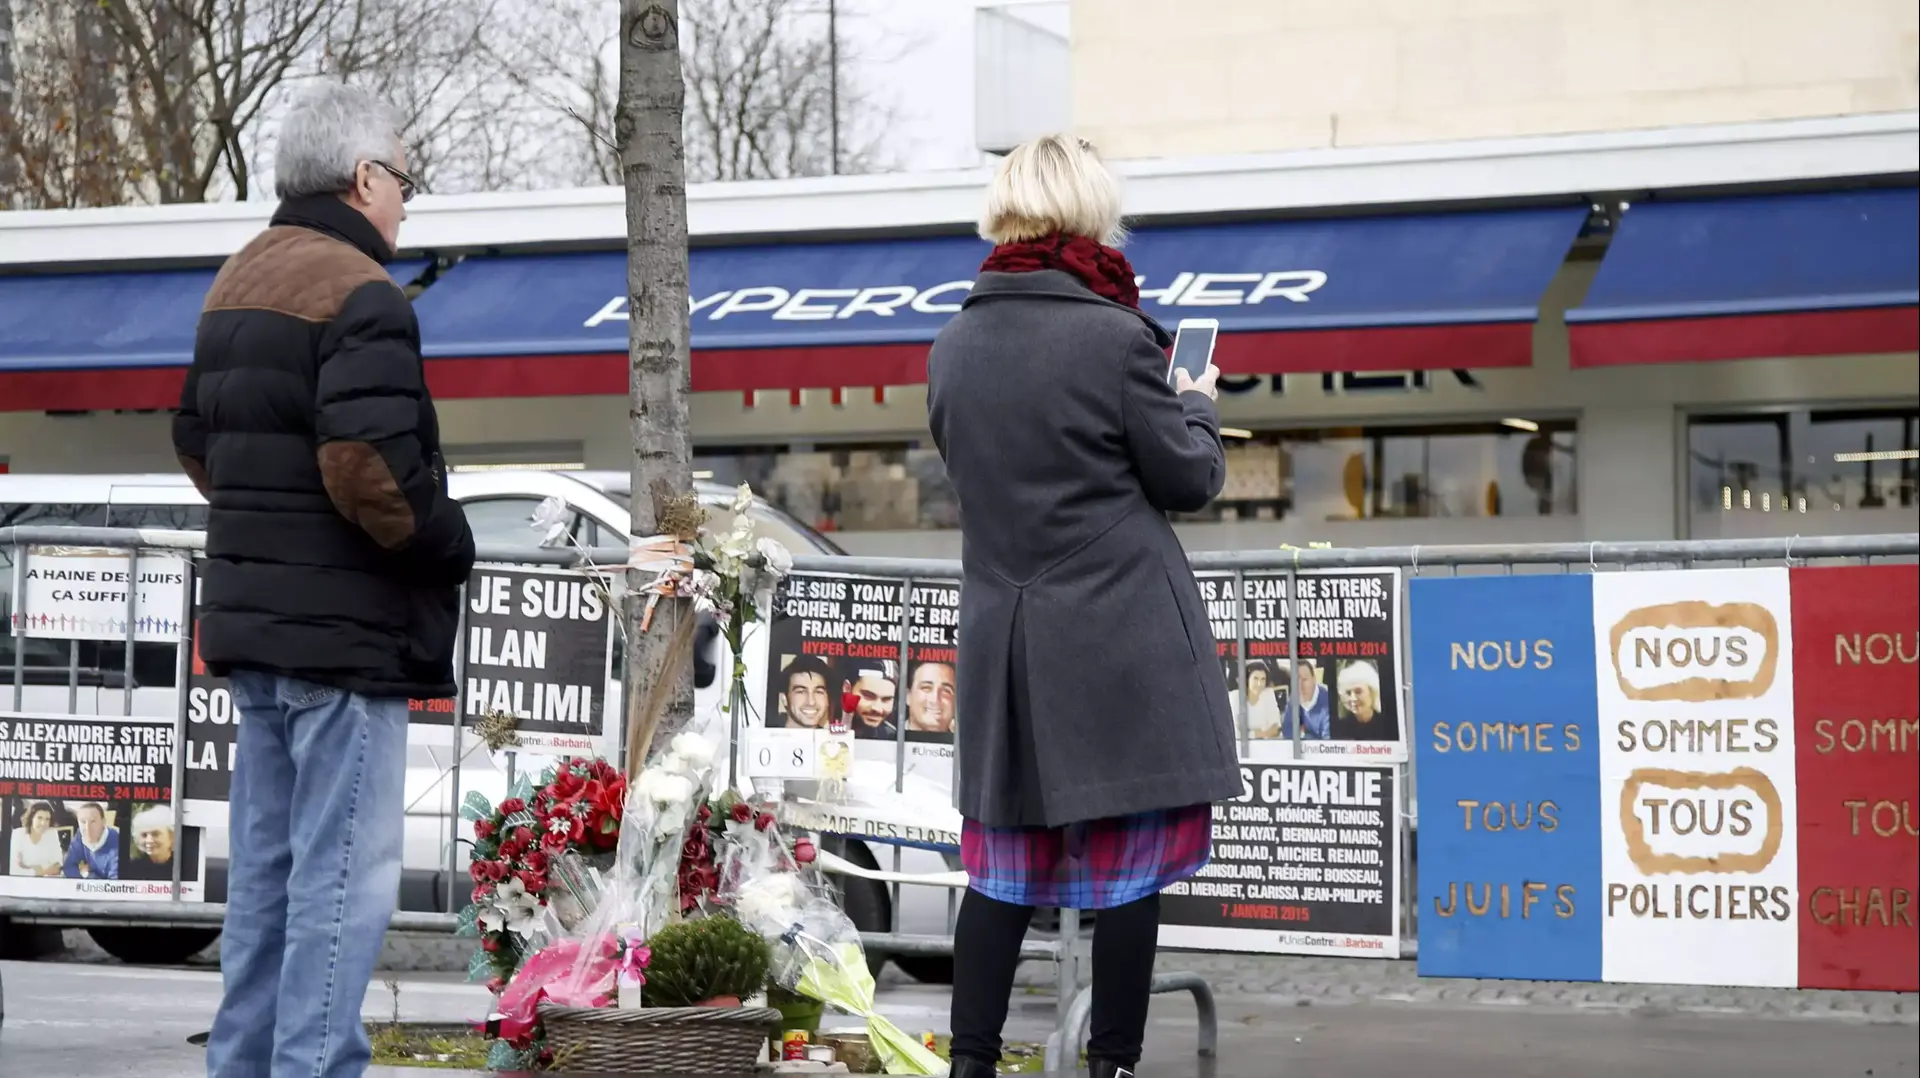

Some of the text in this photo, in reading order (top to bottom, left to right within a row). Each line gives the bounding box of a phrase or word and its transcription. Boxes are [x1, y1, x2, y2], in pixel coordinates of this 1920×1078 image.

[44, 569, 96, 581] HAINE
[138, 572, 183, 584] JUIFS
[52, 590, 73, 603] ÇA
[470, 575, 604, 622] JE SUIS
[786, 579, 805, 597] JE
[809, 581, 847, 600] SUIS
[851, 583, 895, 603] YOAV
[1320, 577, 1387, 600] STRENS,
[786, 599, 846, 622] COHEN,
[1256, 599, 1276, 619] ET
[1344, 597, 1387, 621] RIVA,
[801, 619, 949, 646] FRANÇOIS-MCHEL
[1296, 619, 1354, 639] ABRIER
[469, 626, 546, 669] ILAN
[802, 639, 845, 655] HYPER
[1320, 642, 1334, 655] 24
[1336, 642, 1358, 655] MAI
[1360, 642, 1387, 655] 2014
[1451, 640, 1554, 671] NOUS
[1635, 636, 1748, 667] NOUS
[466, 677, 592, 724] HALIMI
[13, 722, 114, 744] ALEXANDRE
[1432, 722, 1580, 752] SOMMES
[1618, 718, 1779, 753] SOMMES
[45, 743, 66, 761] ET
[71, 744, 141, 764] MIRIAM
[186, 739, 218, 771] LA
[792, 747, 804, 768] 8
[79, 764, 156, 783] SABRIER
[36, 783, 110, 800] BRUXELLES,
[114, 785, 129, 798] 24
[134, 787, 159, 799] MAI
[1260, 768, 1382, 806] CHARLIE
[1230, 806, 1274, 825] CHARB,
[1330, 808, 1384, 828] TIGNOUS,
[1458, 800, 1558, 831] TOUS
[1642, 799, 1753, 836] TOUS
[1211, 824, 1383, 847] ELSA KAYAT, BERNARD MARIS,
[1219, 844, 1274, 863] OURAAD,
[1277, 846, 1325, 863] MICHEL
[1328, 848, 1384, 867] RENAUD,
[1268, 863, 1322, 882] FRÉDÉRIC
[1325, 868, 1383, 886] BOISSEAU,
[1191, 882, 1246, 901] MERABET,
[1247, 884, 1299, 901] CLARISSA
[1301, 887, 1383, 904] JEAN-PHILIPPE
[1434, 882, 1576, 920] JUIFS
[1608, 884, 1791, 921] POLICIERS
[1221, 903, 1310, 921] 7 JANVIER 2015
[1809, 886, 1913, 927] CHAR
